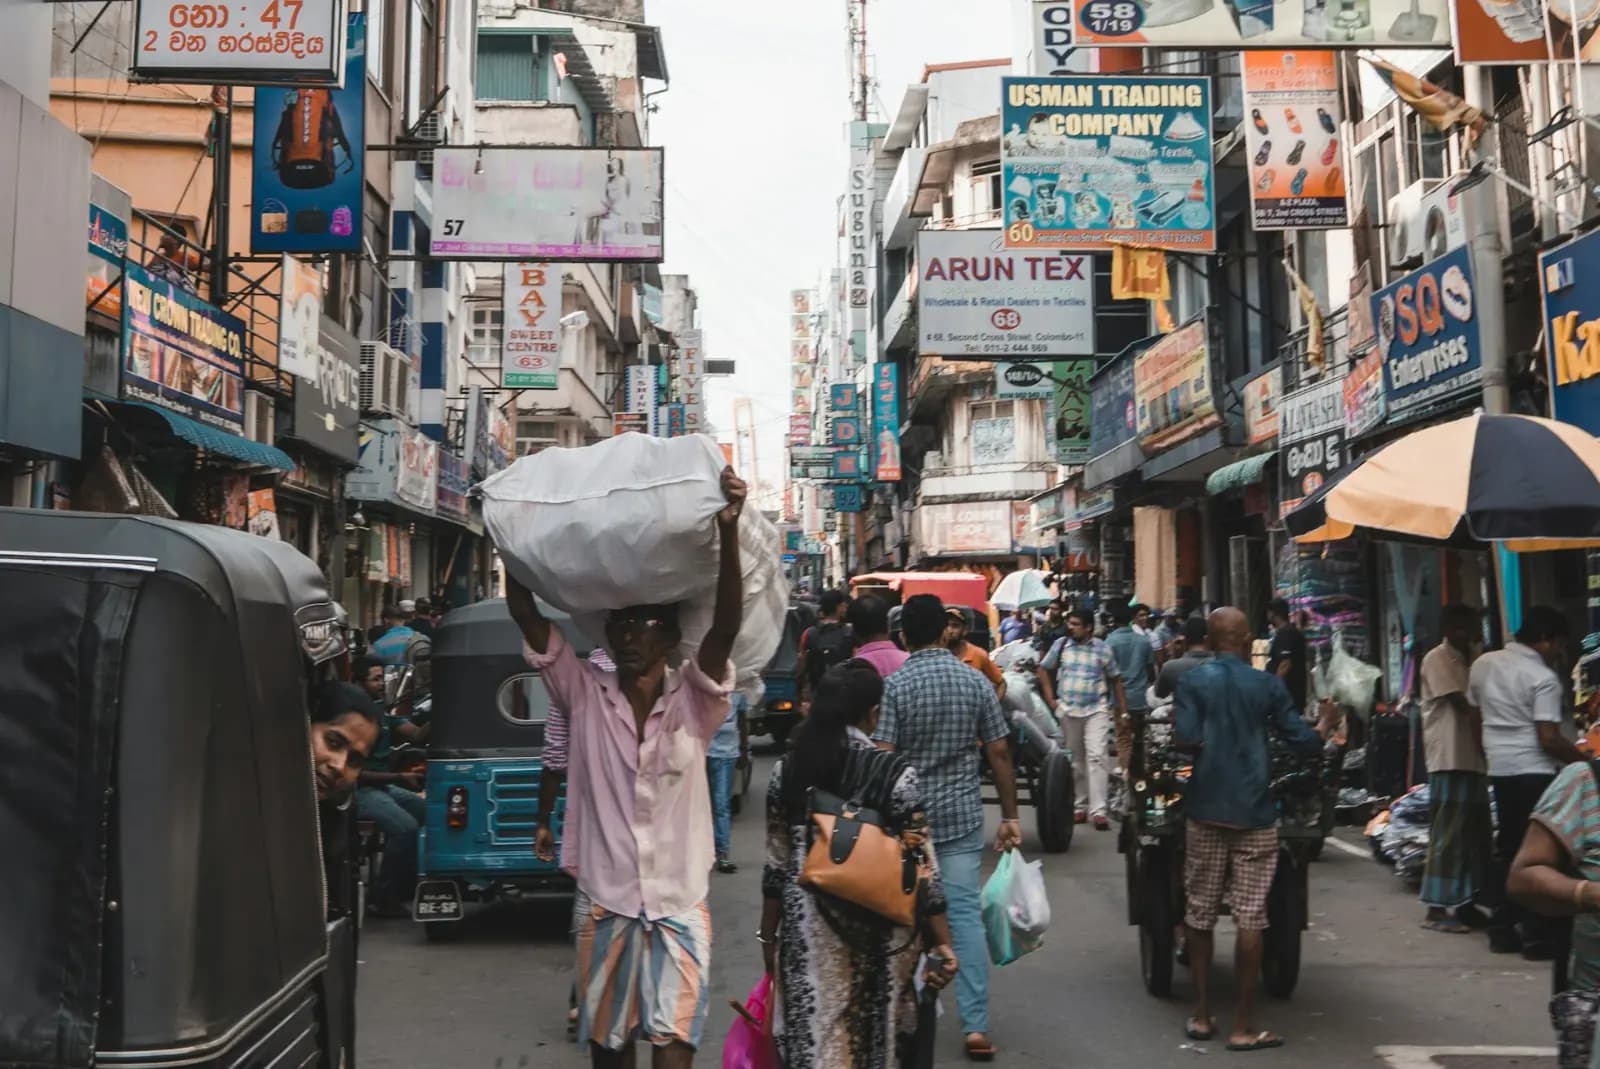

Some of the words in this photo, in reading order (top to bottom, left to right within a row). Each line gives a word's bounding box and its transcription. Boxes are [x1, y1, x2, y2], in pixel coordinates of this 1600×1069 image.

[260, 0, 304, 30] 47
[1089, 3, 1136, 19] 58
[1091, 20, 1132, 31] 1/19
[143, 30, 158, 52] 2
[169, 31, 207, 52] වන
[1043, 7, 1077, 74] ODY
[1008, 84, 1094, 107] USMAN
[1098, 84, 1202, 108] TRADING
[1049, 113, 1164, 136] COMPANY
[443, 219, 464, 236] 57
[1008, 224, 1033, 242] 60
[925, 257, 1014, 281] ARUN
[1024, 257, 1084, 281] TEX
[518, 261, 549, 327] BAY
[924, 297, 969, 306] Wholesale
[981, 297, 1005, 306] Retail
[1008, 297, 1040, 306] Dealers
[1053, 298, 1086, 306] Textiles
[994, 312, 1018, 326] 68
[1395, 272, 1445, 346] SQ
[153, 292, 188, 334] CROWN
[189, 310, 227, 352] TRADING
[511, 330, 553, 340] SWEET
[948, 333, 979, 341] Second
[980, 333, 1004, 341] Cross
[506, 342, 558, 352] CENTRE
[519, 357, 542, 367] 63
[1389, 335, 1469, 390] Enterprises
